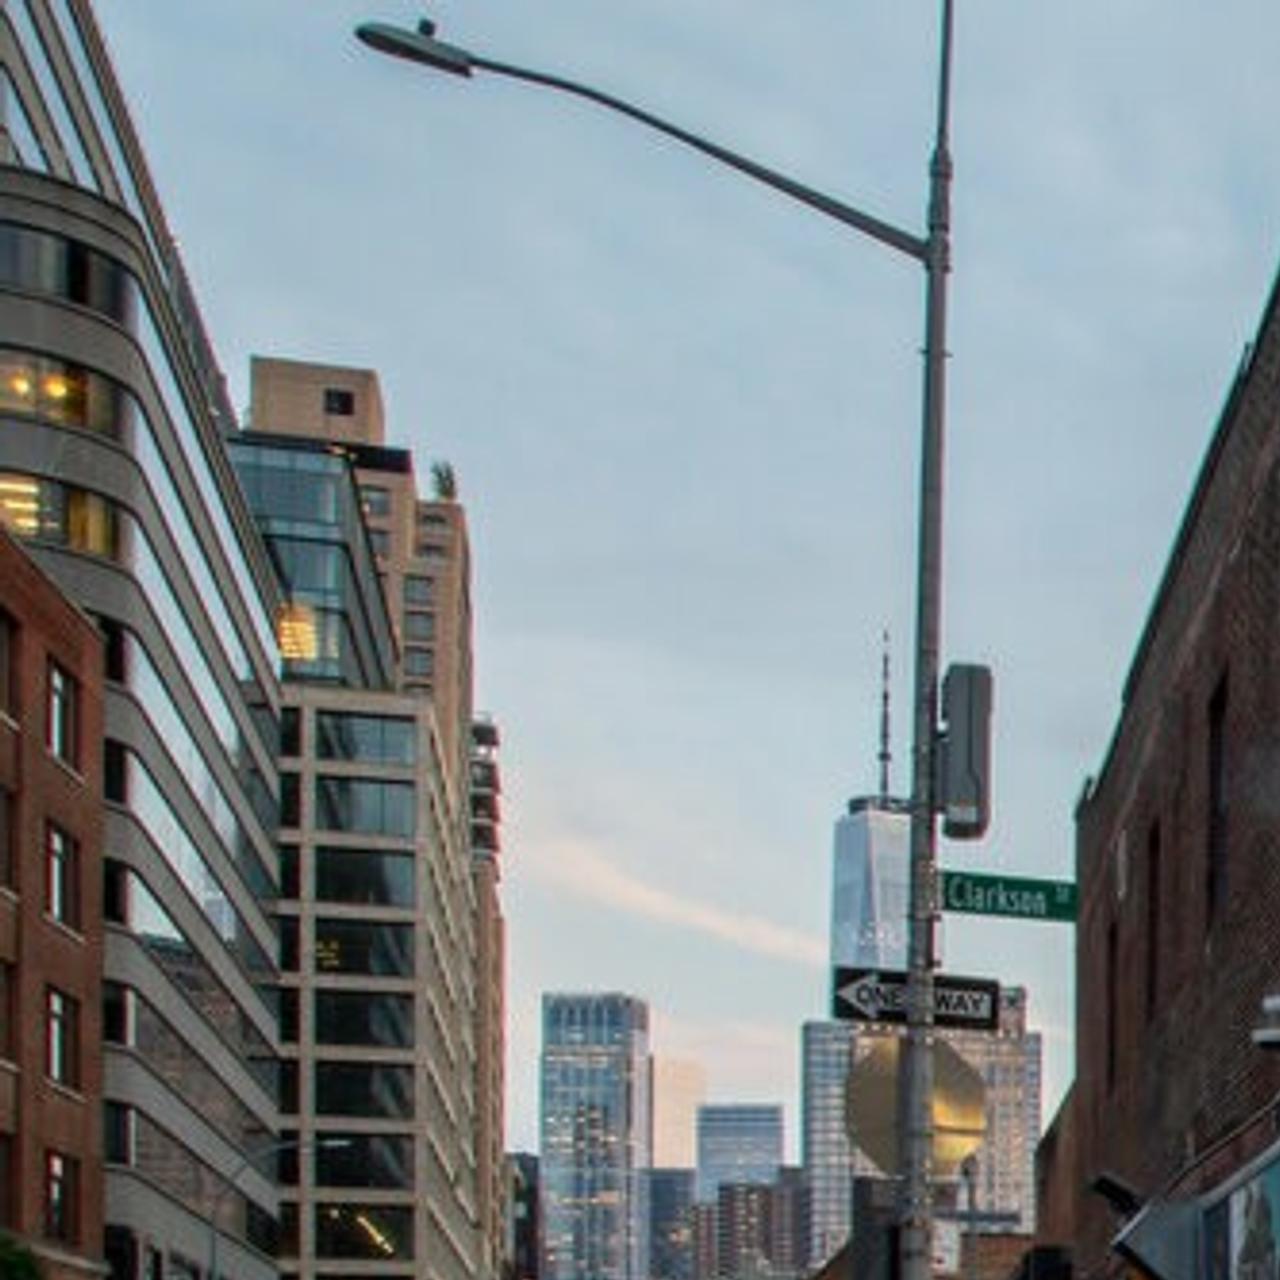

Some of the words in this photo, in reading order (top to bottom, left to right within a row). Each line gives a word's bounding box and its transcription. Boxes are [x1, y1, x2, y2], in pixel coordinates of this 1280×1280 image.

[949, 875, 1046, 915] Clarkson
[857, 983, 903, 1011] ONE
[935, 991, 984, 1012] WAY
